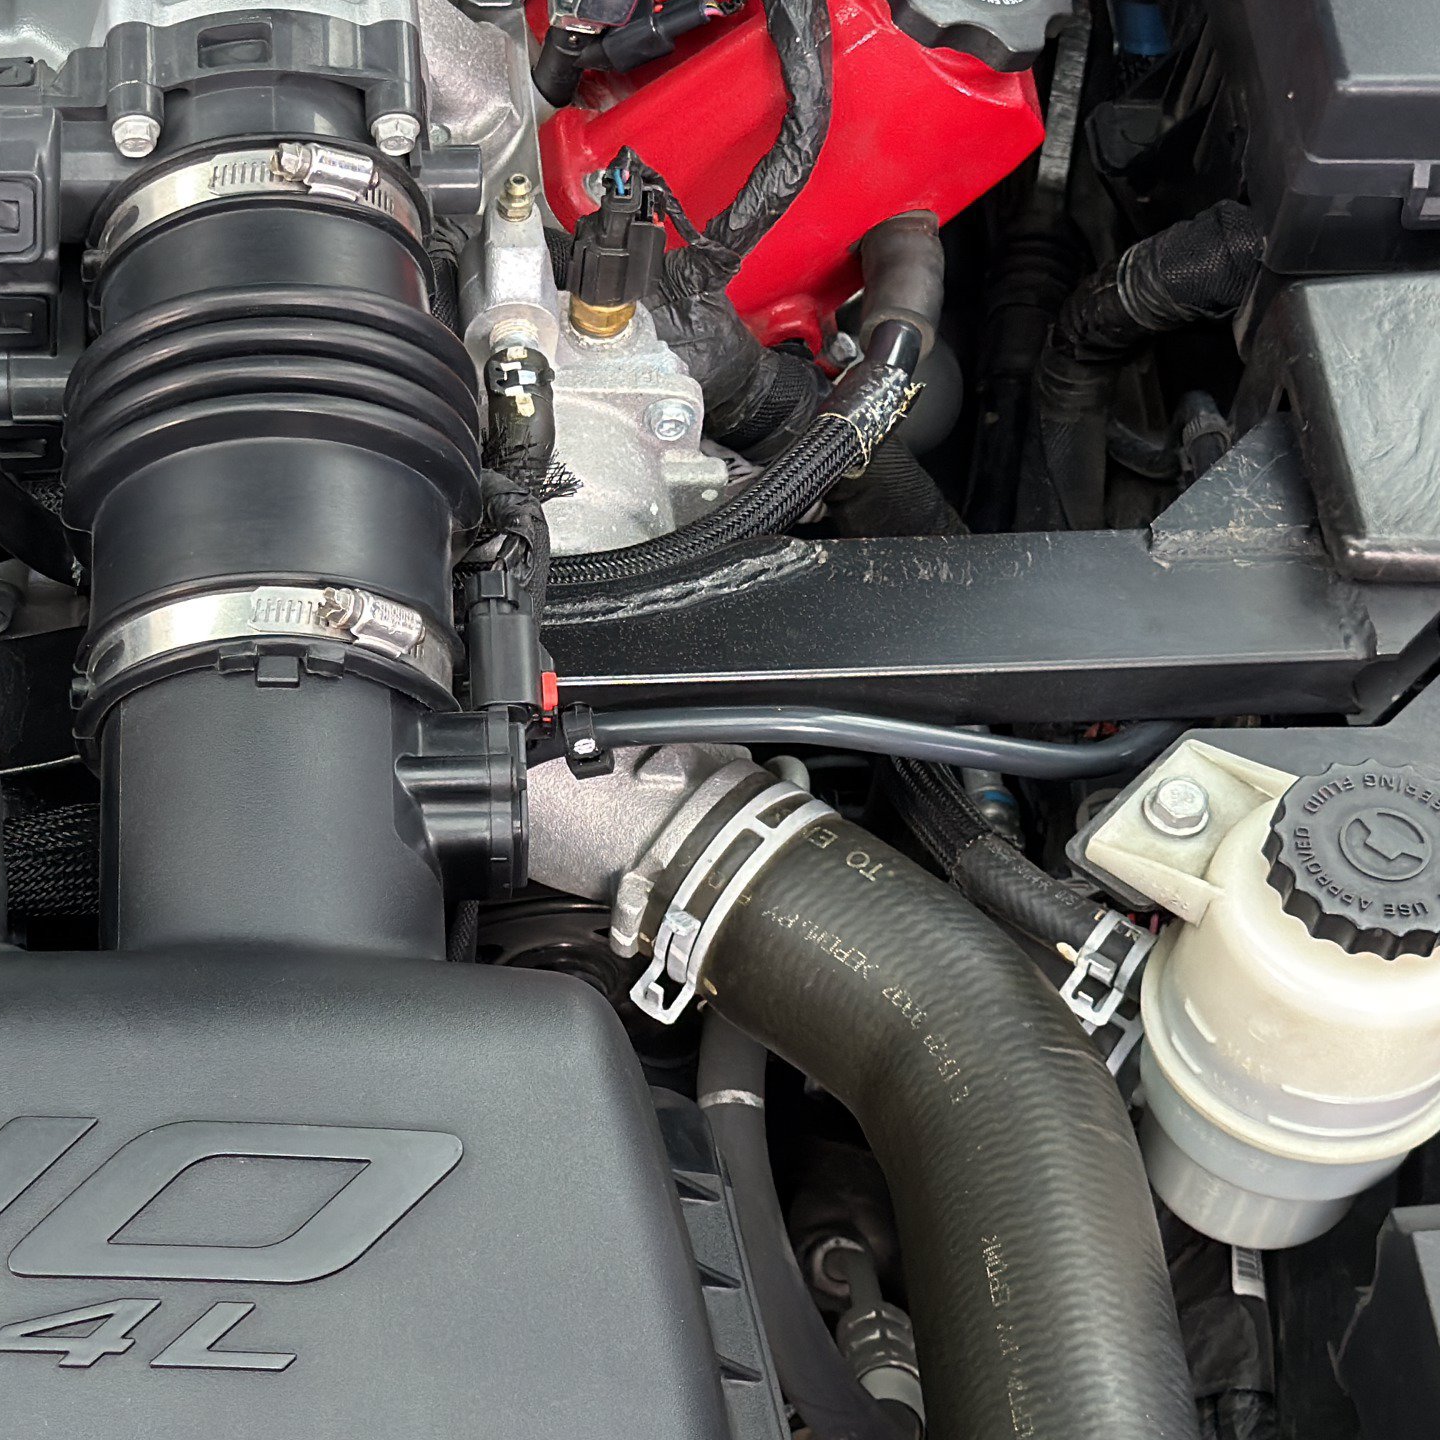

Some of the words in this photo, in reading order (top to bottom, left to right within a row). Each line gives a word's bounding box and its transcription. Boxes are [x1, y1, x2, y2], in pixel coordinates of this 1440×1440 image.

[1303, 776, 1355, 814] FLUID
[845, 850, 883, 882] TO
[1293, 826, 1369, 912] APPROVED
[1383, 901, 1429, 918] USE
